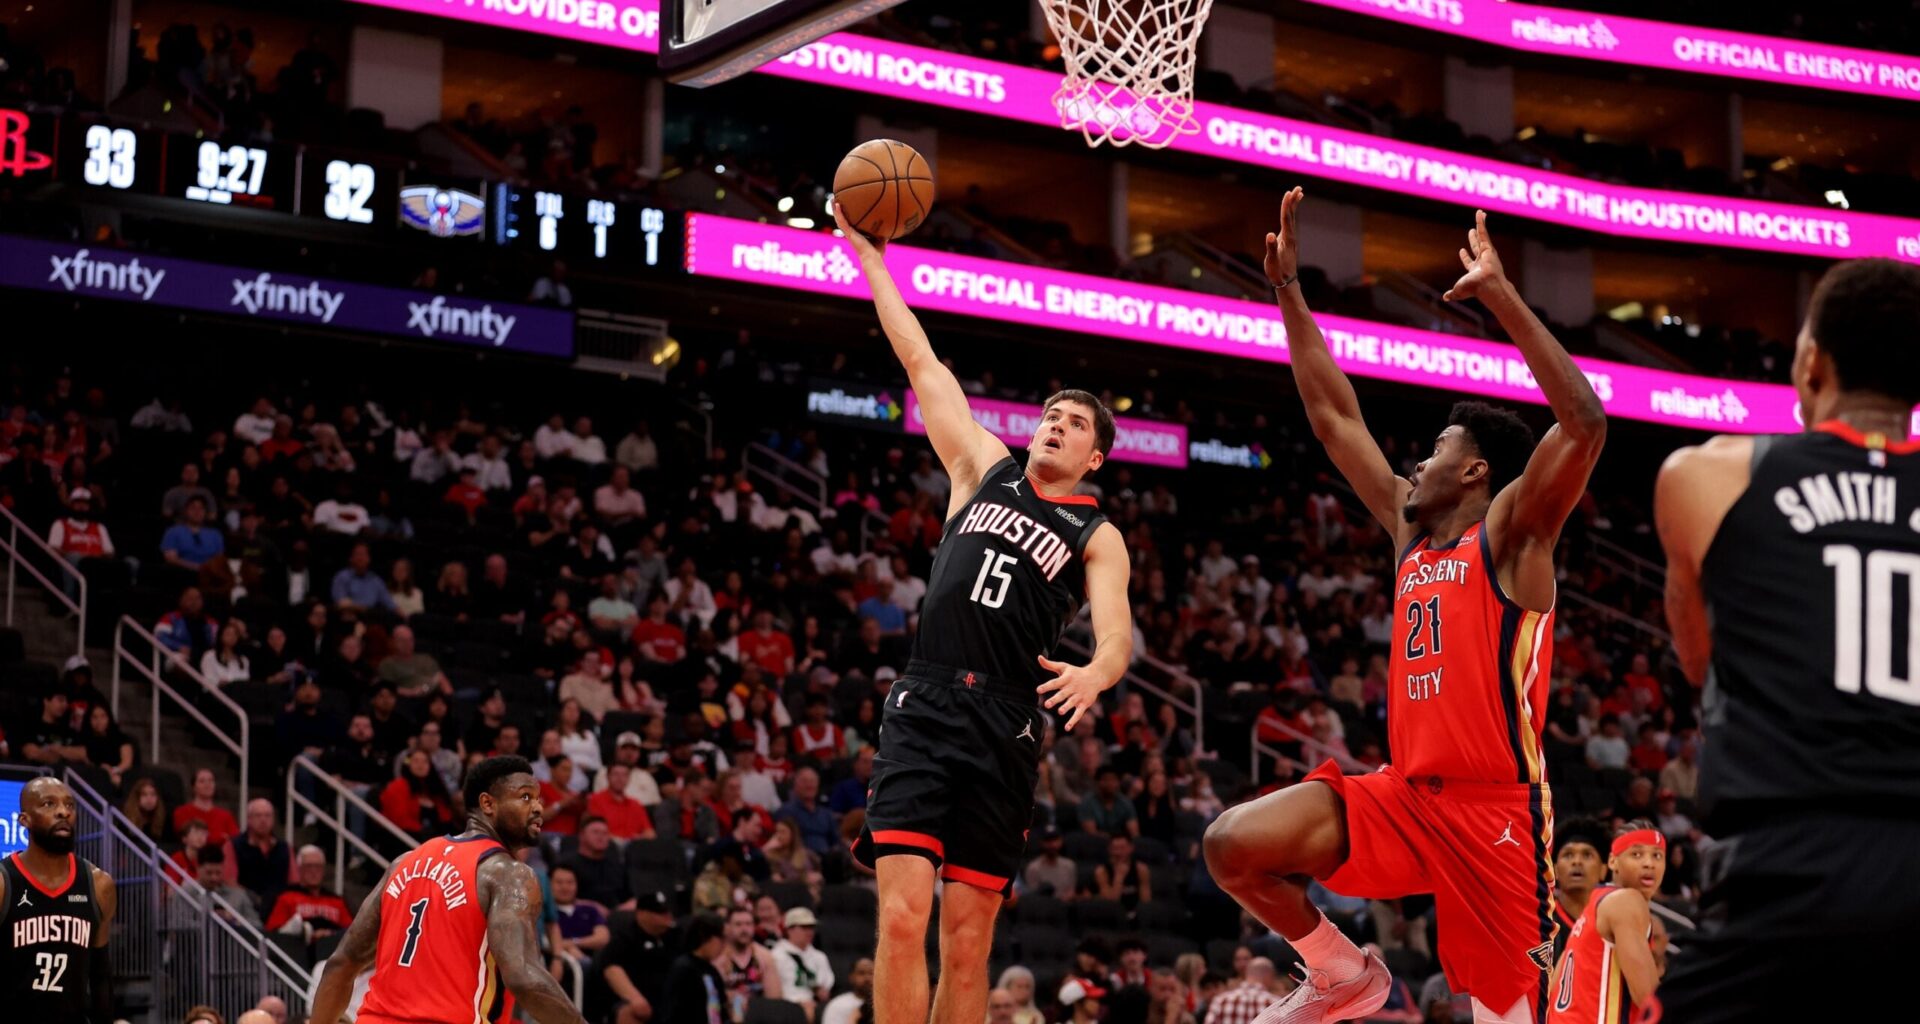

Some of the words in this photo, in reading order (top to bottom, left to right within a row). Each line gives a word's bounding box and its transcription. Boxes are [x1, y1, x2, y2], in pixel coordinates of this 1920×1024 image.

[1511, 16, 1592, 48] reliant
[877, 54, 1006, 103] ROCKETS
[1673, 36, 1782, 73] OFFICIAL
[1784, 51, 1874, 84] ENERGY
[84, 125, 137, 189] 33
[197, 141, 267, 195] 9:27
[1206, 117, 1320, 163] OFFICIAL
[1320, 138, 1415, 181] ENERGY
[1415, 157, 1529, 204] PROVIDER
[1528, 181, 1562, 210] OF
[1562, 188, 1608, 221] THE
[1610, 197, 1736, 235] HOUSTON
[1737, 210, 1851, 248] ROCKETS
[324, 160, 375, 224] 32
[594, 225, 607, 258] 1
[645, 232, 658, 266] 1
[732, 240, 826, 282] reliant
[49, 249, 165, 300] xfinity
[231, 272, 344, 323] xfinity
[407, 296, 516, 346] xfinity
[911, 264, 1043, 310] OFFICIAL
[1045, 284, 1155, 327] ENERGY
[1156, 301, 1289, 349] PROVIDER
[1331, 329, 1381, 364] THE
[1382, 339, 1502, 384] HOUSTON
[807, 389, 877, 420] reliant
[1650, 387, 1723, 422] reliant
[1189, 438, 1251, 468] reliant
[1774, 471, 1897, 534] SMITH
[957, 502, 1073, 583] HOUSTON
[969, 547, 1019, 609] 15
[1405, 593, 1442, 661] 21
[1822, 544, 1920, 707] 10
[1407, 667, 1443, 701] CITY
[13, 914, 92, 949] HOUSTON
[398, 897, 430, 968] 1
[32, 952, 69, 992] 32
